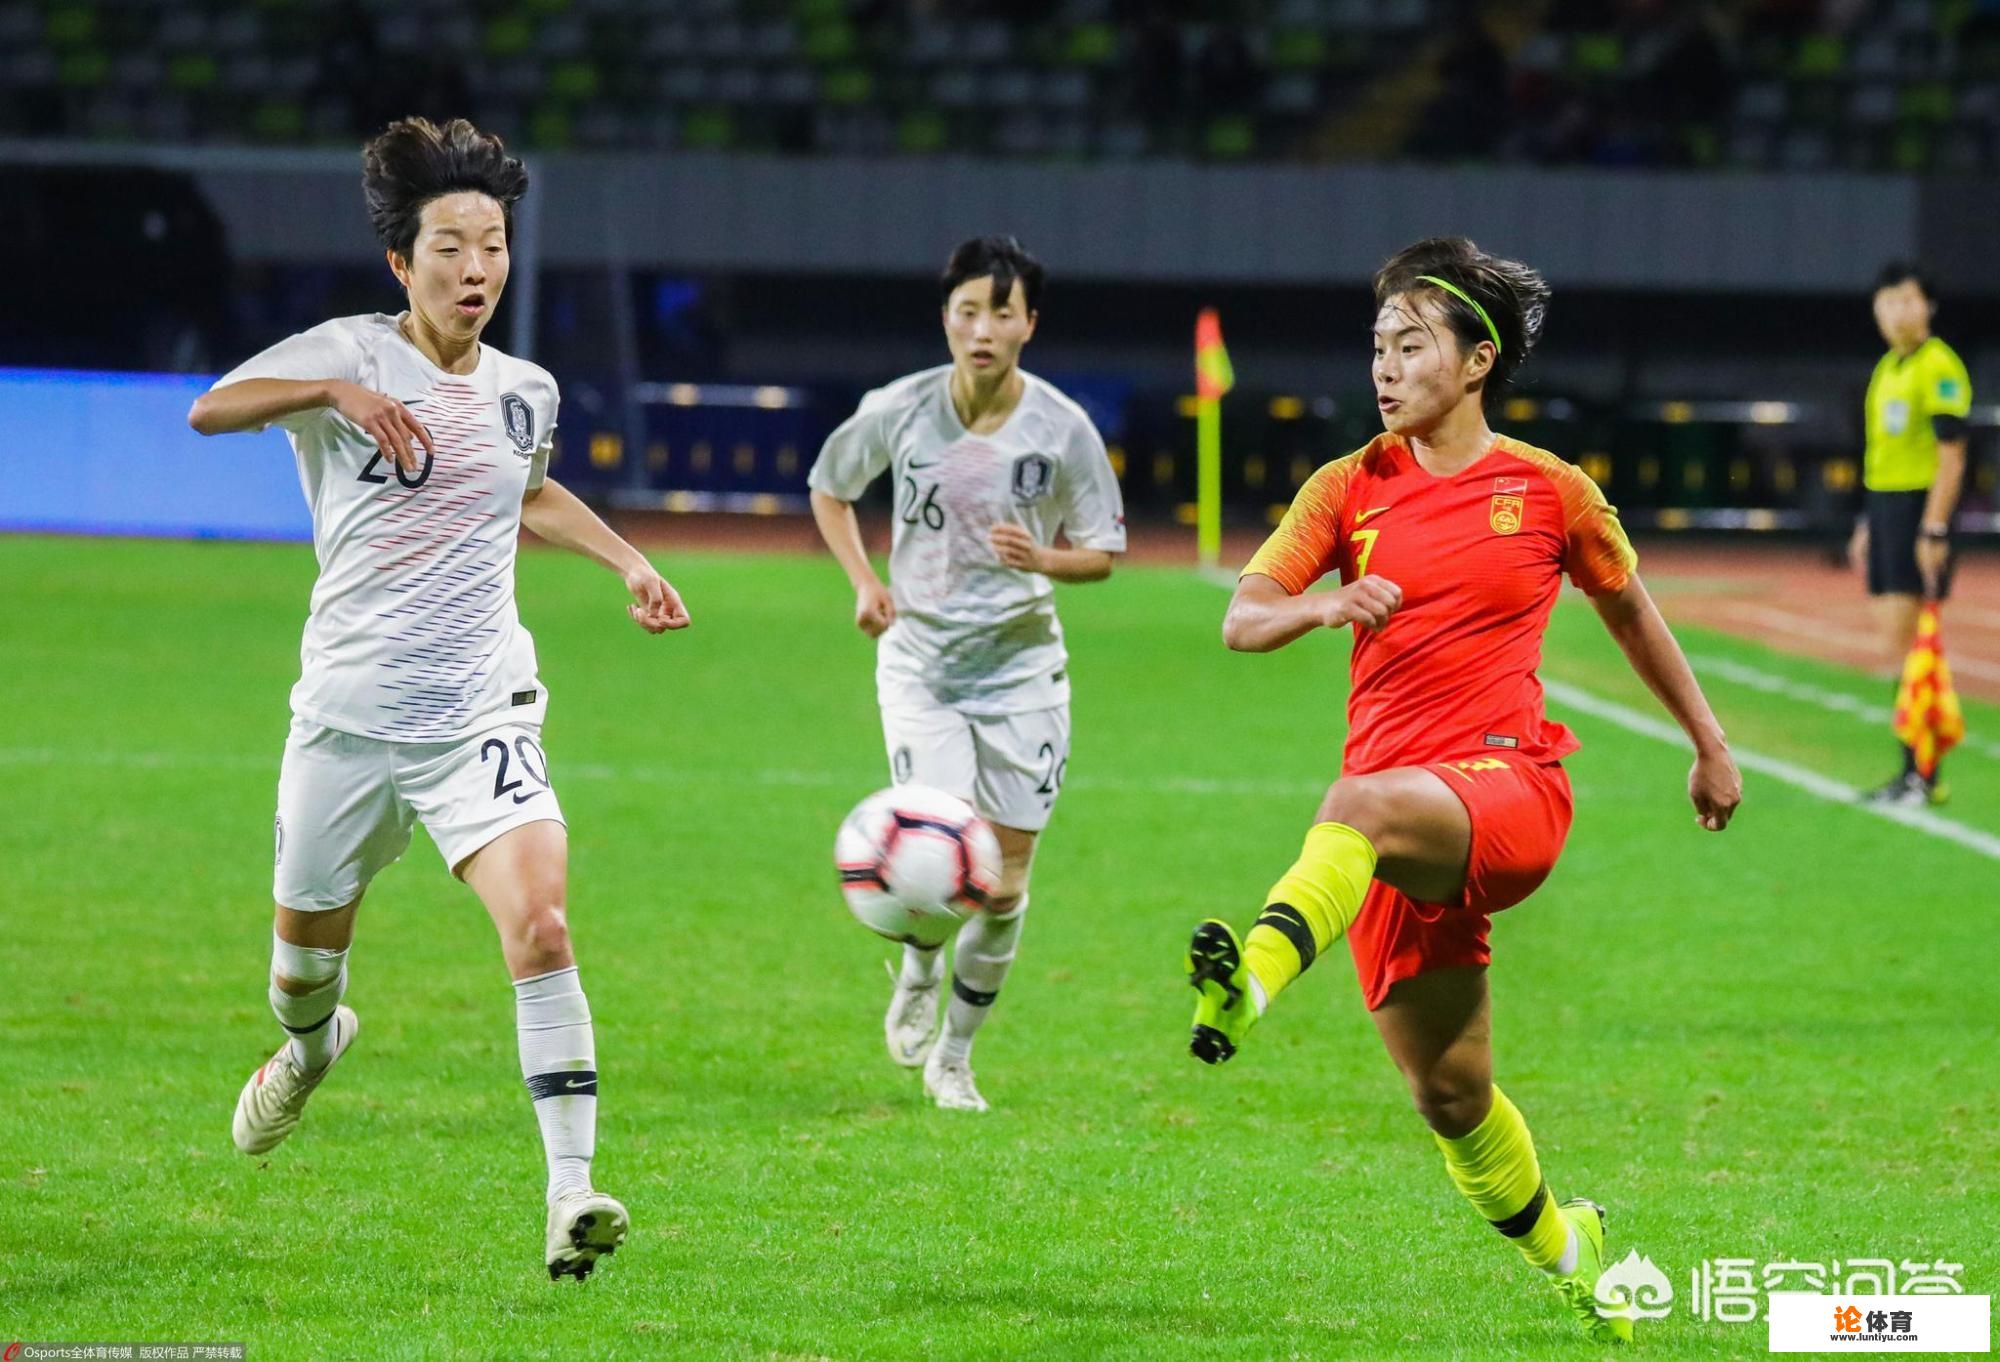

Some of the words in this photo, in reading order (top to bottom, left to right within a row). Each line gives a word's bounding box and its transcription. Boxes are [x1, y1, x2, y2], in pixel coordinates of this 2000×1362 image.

[903, 476, 945, 530] 26
[1351, 529, 1380, 579] 7
[481, 735, 550, 800] 20
